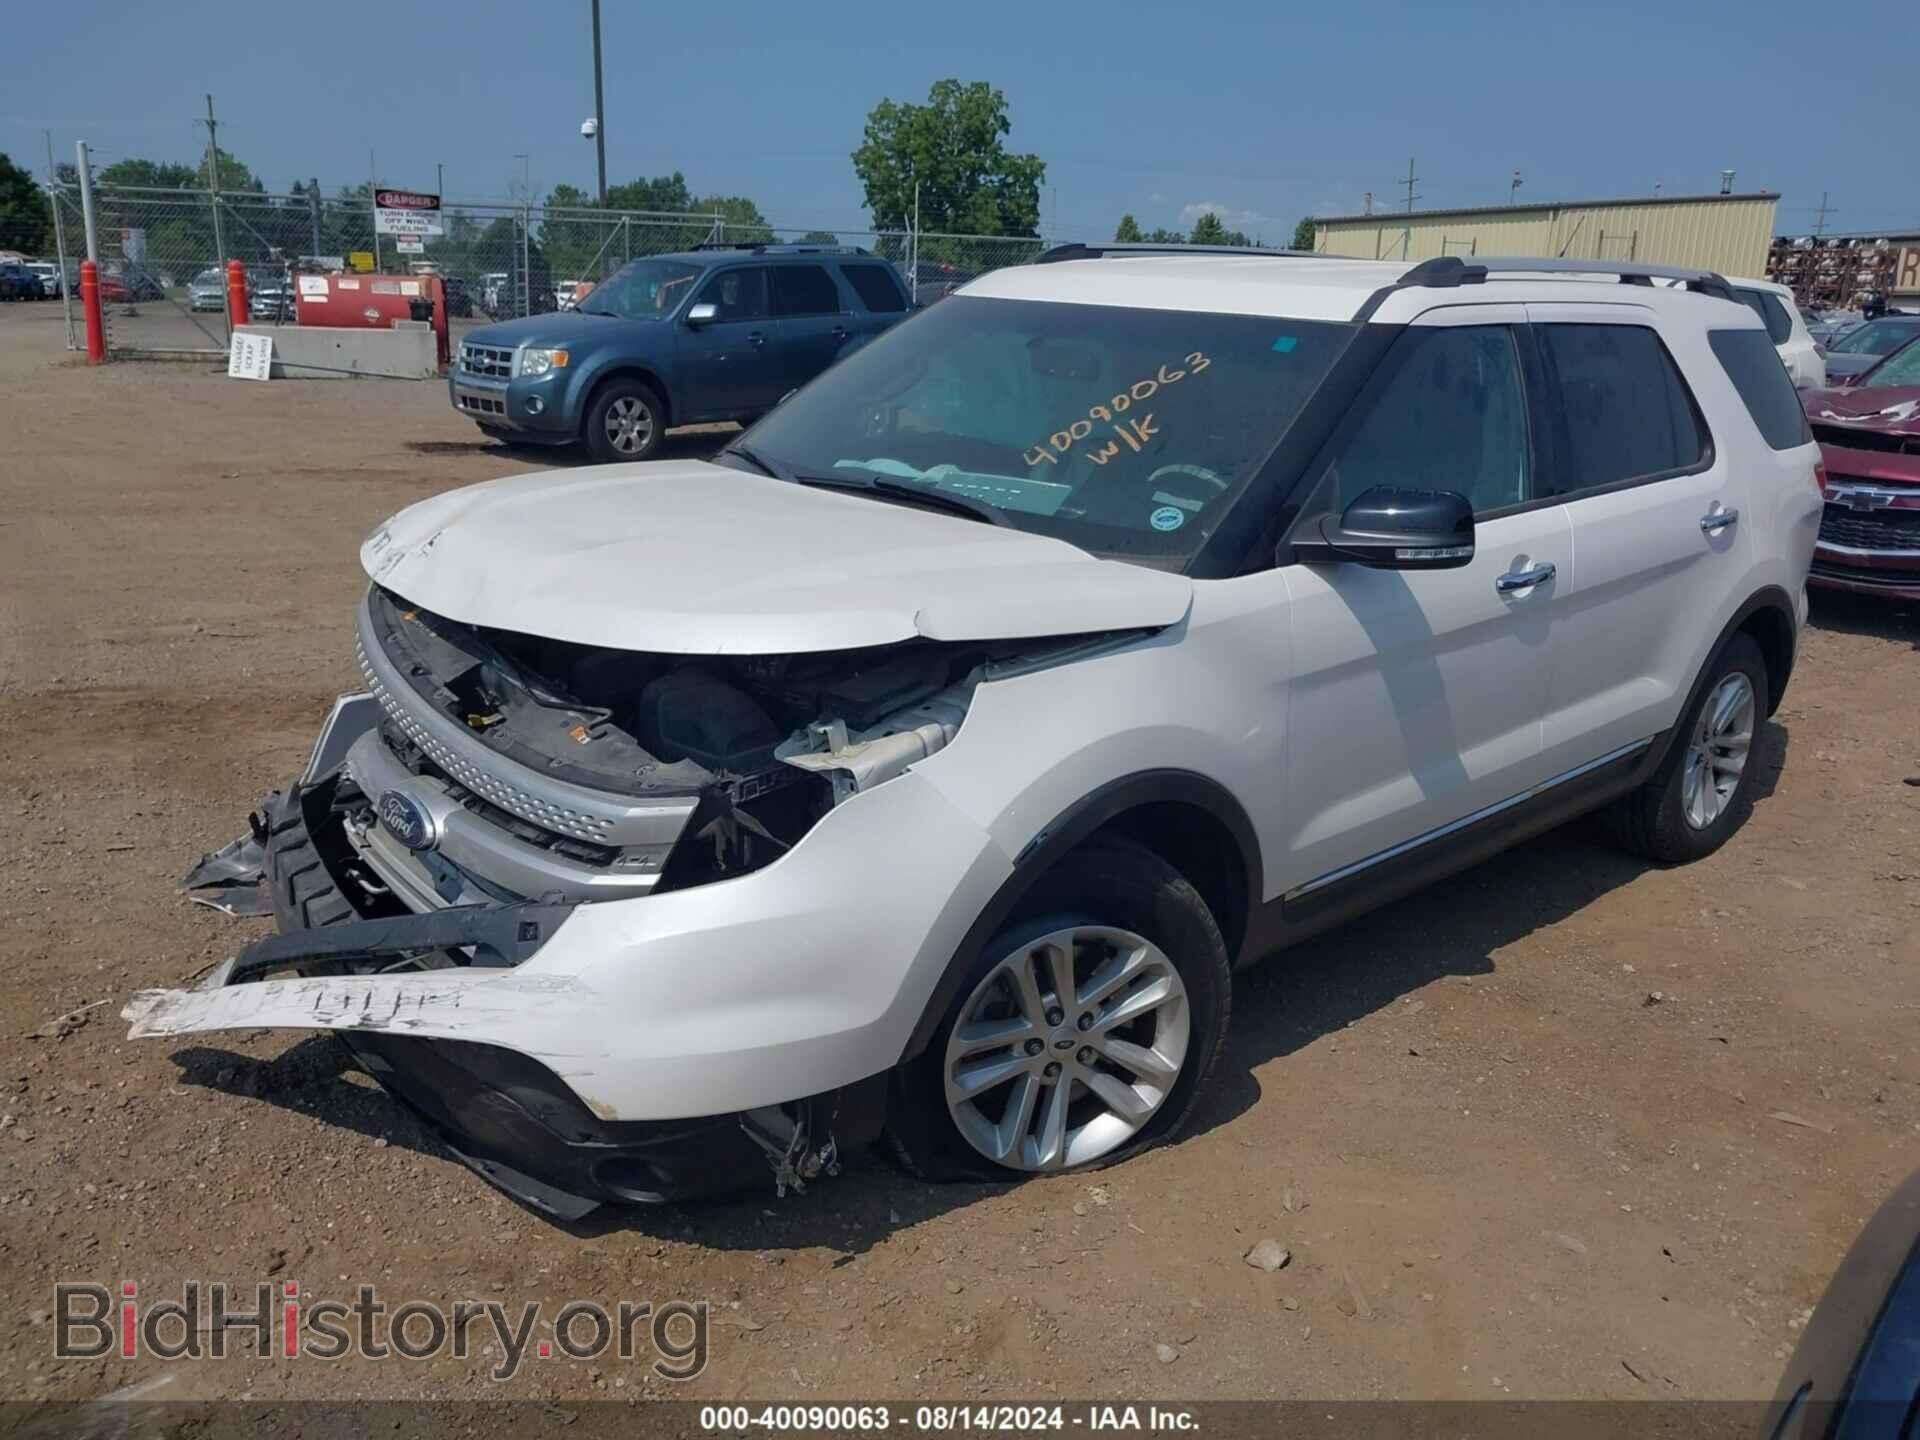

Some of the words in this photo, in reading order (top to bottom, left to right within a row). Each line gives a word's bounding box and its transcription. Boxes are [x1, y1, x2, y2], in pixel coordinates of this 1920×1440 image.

[384, 193, 432, 206] DANGER
[390, 225, 430, 233] FUELING
[1024, 352, 1211, 465] 40090063
[383, 798, 417, 837] Ford
